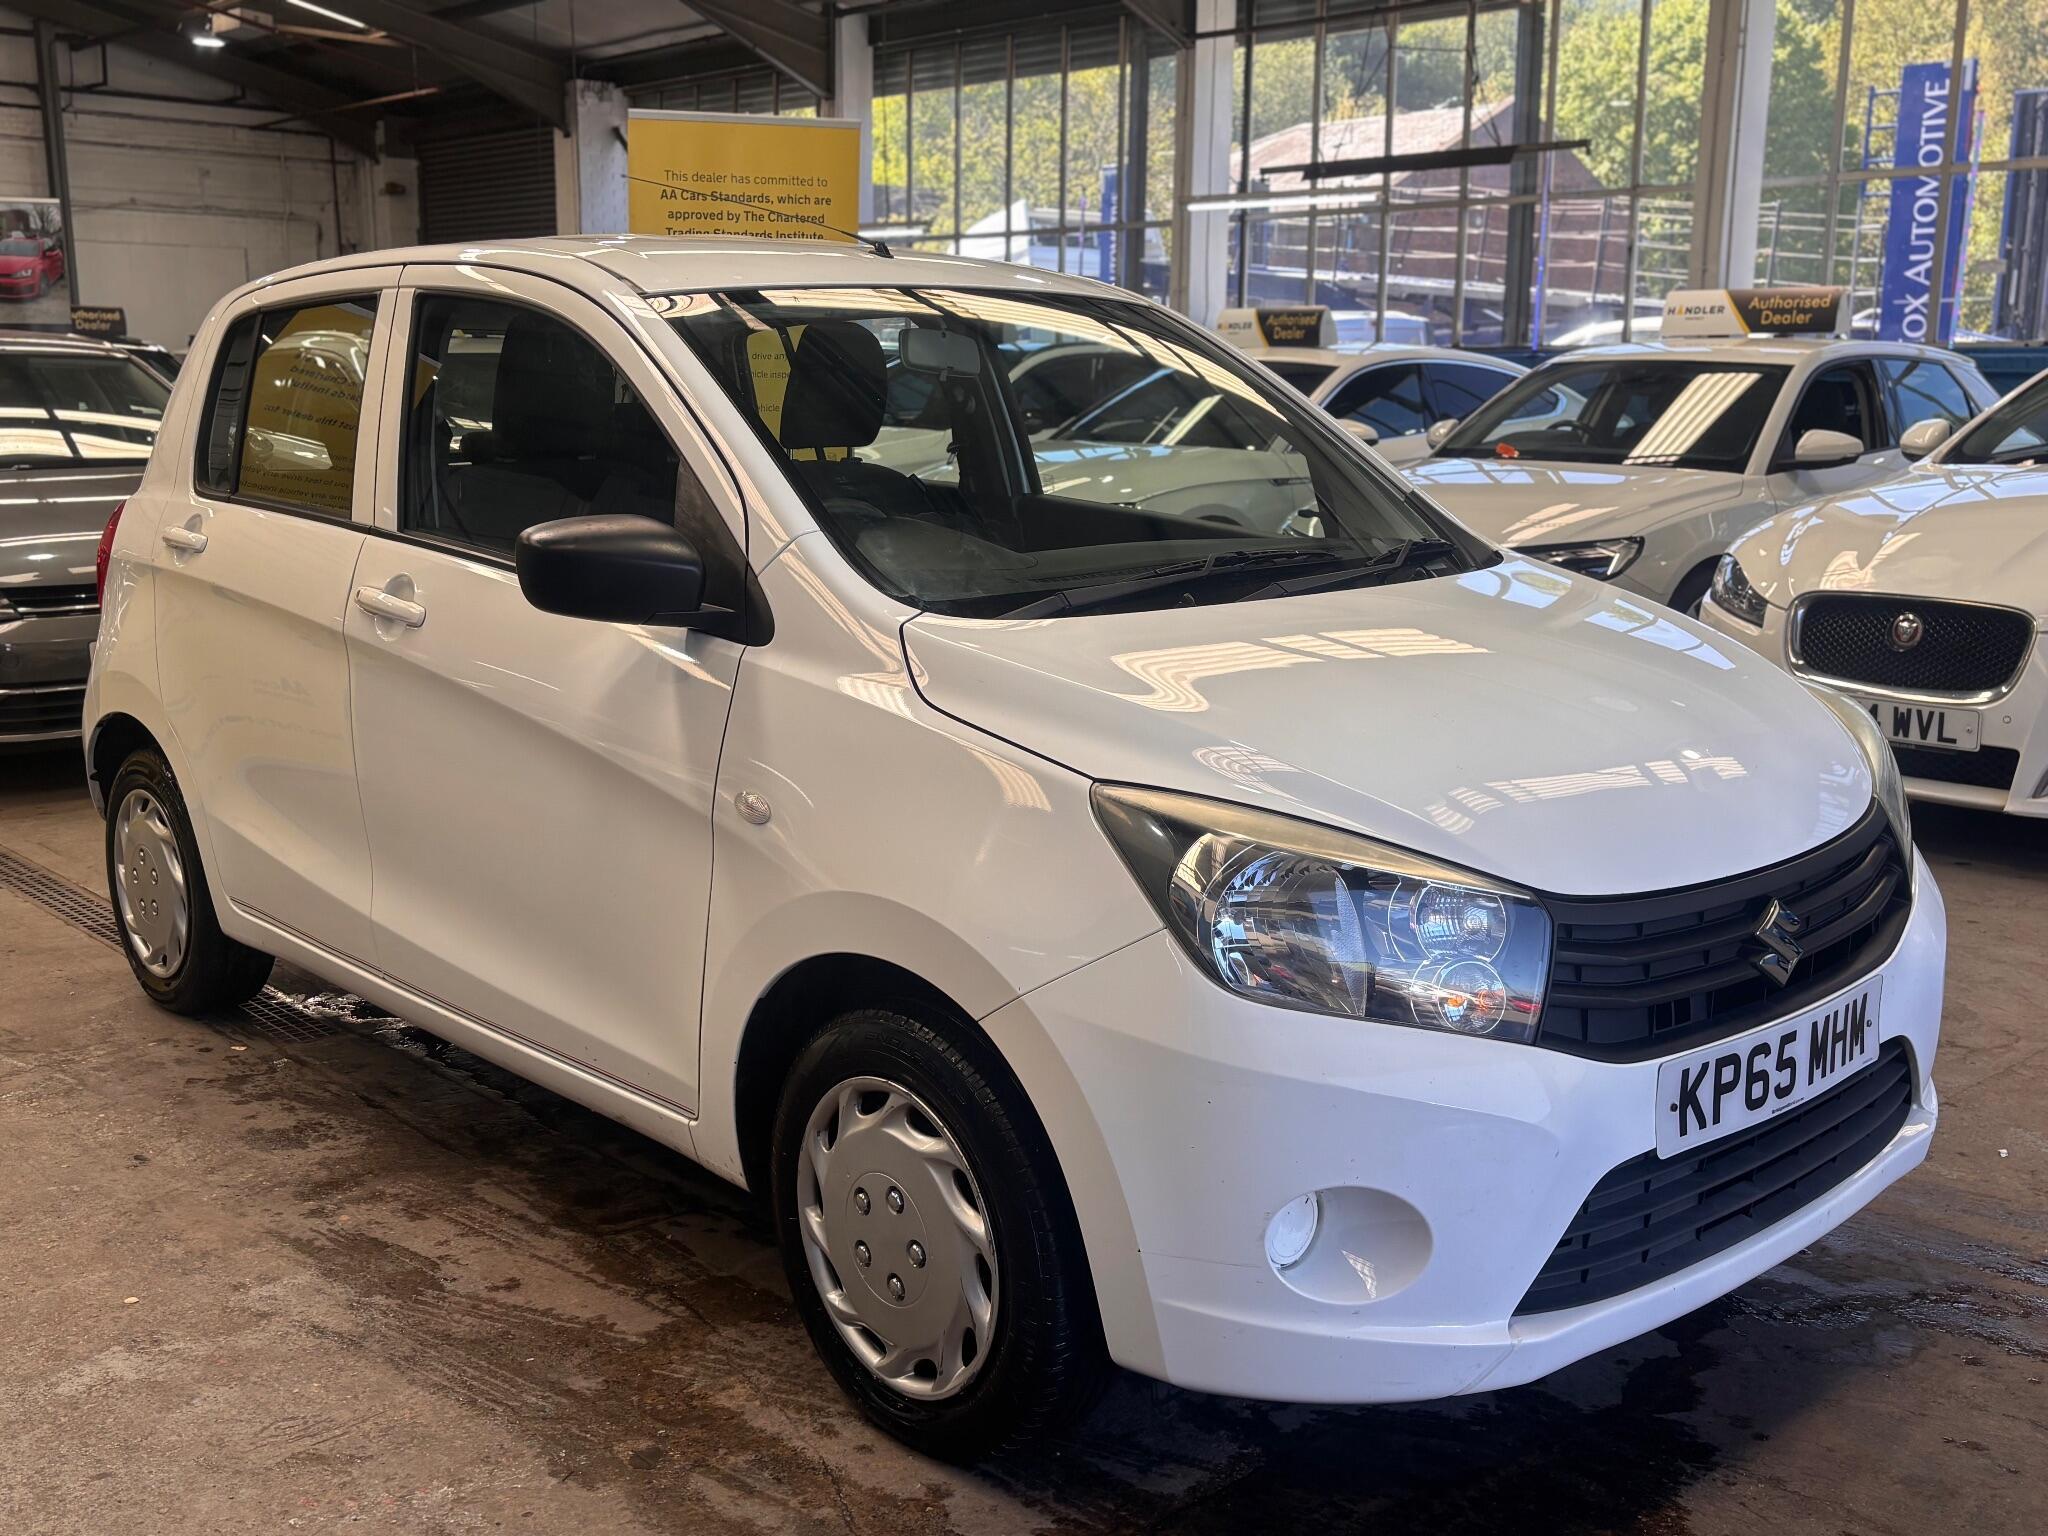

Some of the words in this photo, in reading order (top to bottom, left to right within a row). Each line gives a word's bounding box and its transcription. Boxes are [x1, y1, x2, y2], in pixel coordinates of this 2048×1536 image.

[664, 169, 688, 182] This
[691, 171, 727, 183] dealer
[731, 172, 751, 184] has
[753, 175, 814, 187] committed
[817, 177, 828, 187] to
[1903, 78, 1950, 286] AUTOMOTIVE
[660, 188, 678, 200] AA
[680, 189, 708, 201] Cars
[710, 190, 774, 205] Standards,
[777, 193, 811, 205] which
[814, 196, 832, 206] are
[667, 209, 723, 221] approved
[727, 210, 741, 223] by
[743, 210, 765, 222] The
[768, 210, 825, 224] Chartered
[1748, 294, 1832, 310] Authorised
[71, 309, 121, 321] uthorised
[1266, 312, 1319, 326] Authorised
[1760, 310, 1813, 325] Dealer
[1898, 293, 1930, 343] OX
[1273, 326, 1305, 339] Dealer
[751, 352, 772, 360] drive
[1892, 705, 1958, 745] WVL
[1678, 1030, 1798, 1137] KP65
[1807, 993, 1868, 1087] MHM
